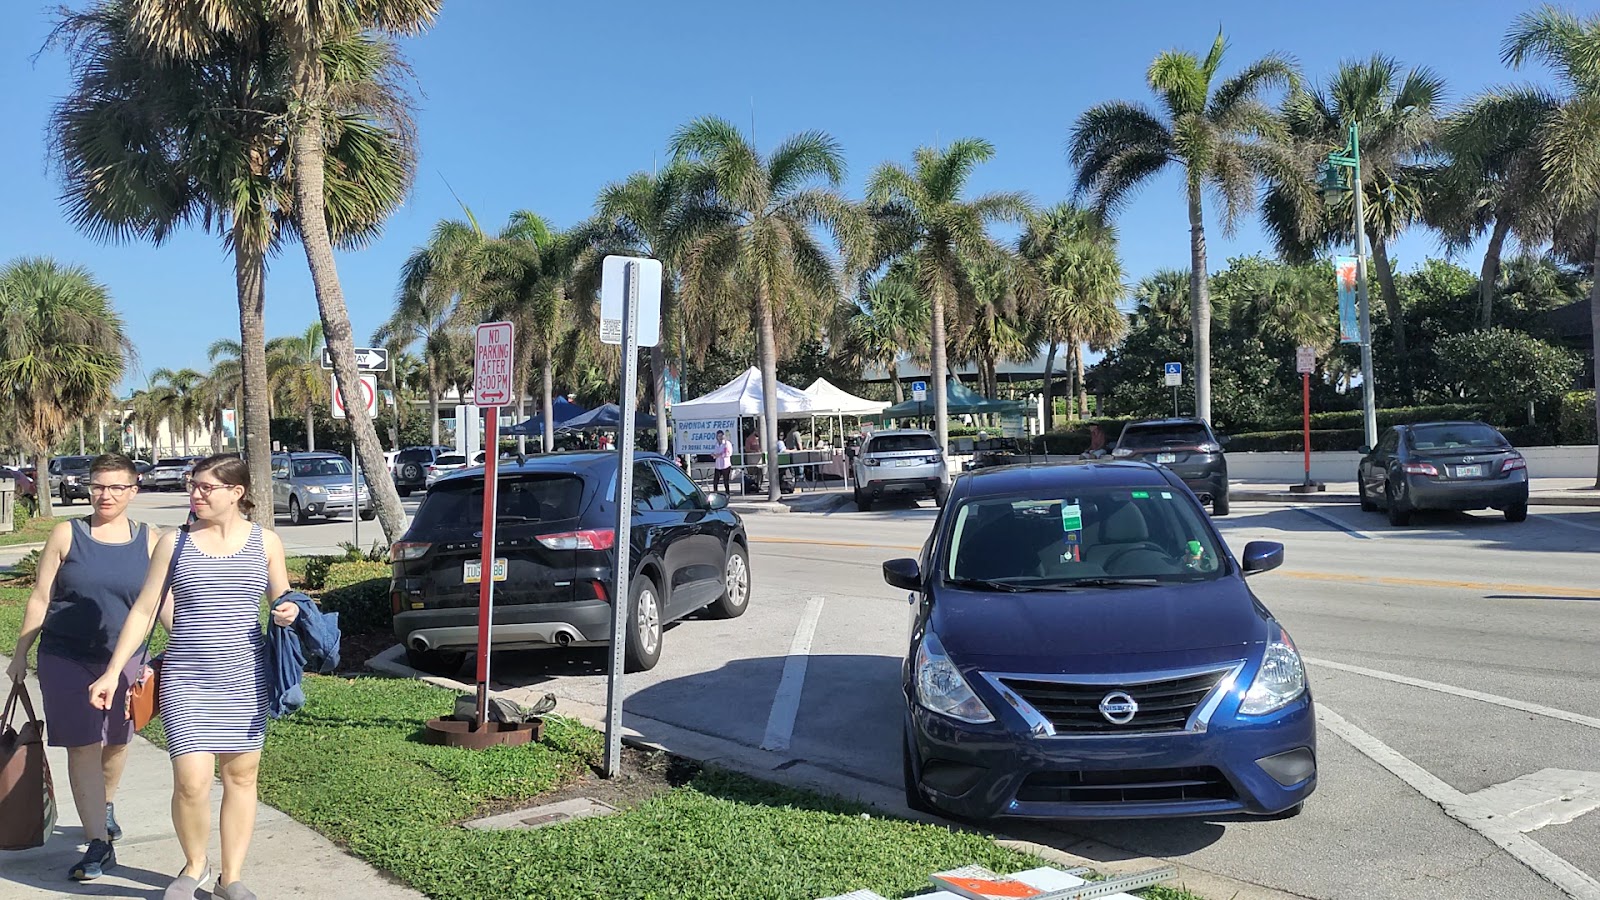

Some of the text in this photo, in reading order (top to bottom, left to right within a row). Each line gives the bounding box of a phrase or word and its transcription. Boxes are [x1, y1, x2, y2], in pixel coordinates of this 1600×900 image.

[488, 329, 500, 344] NO
[479, 344, 509, 360] PARKING
[481, 360, 506, 375] AFTER
[478, 374, 508, 390] 3:00 PM
[679, 420, 735, 430] RHONDA'S FRESH
